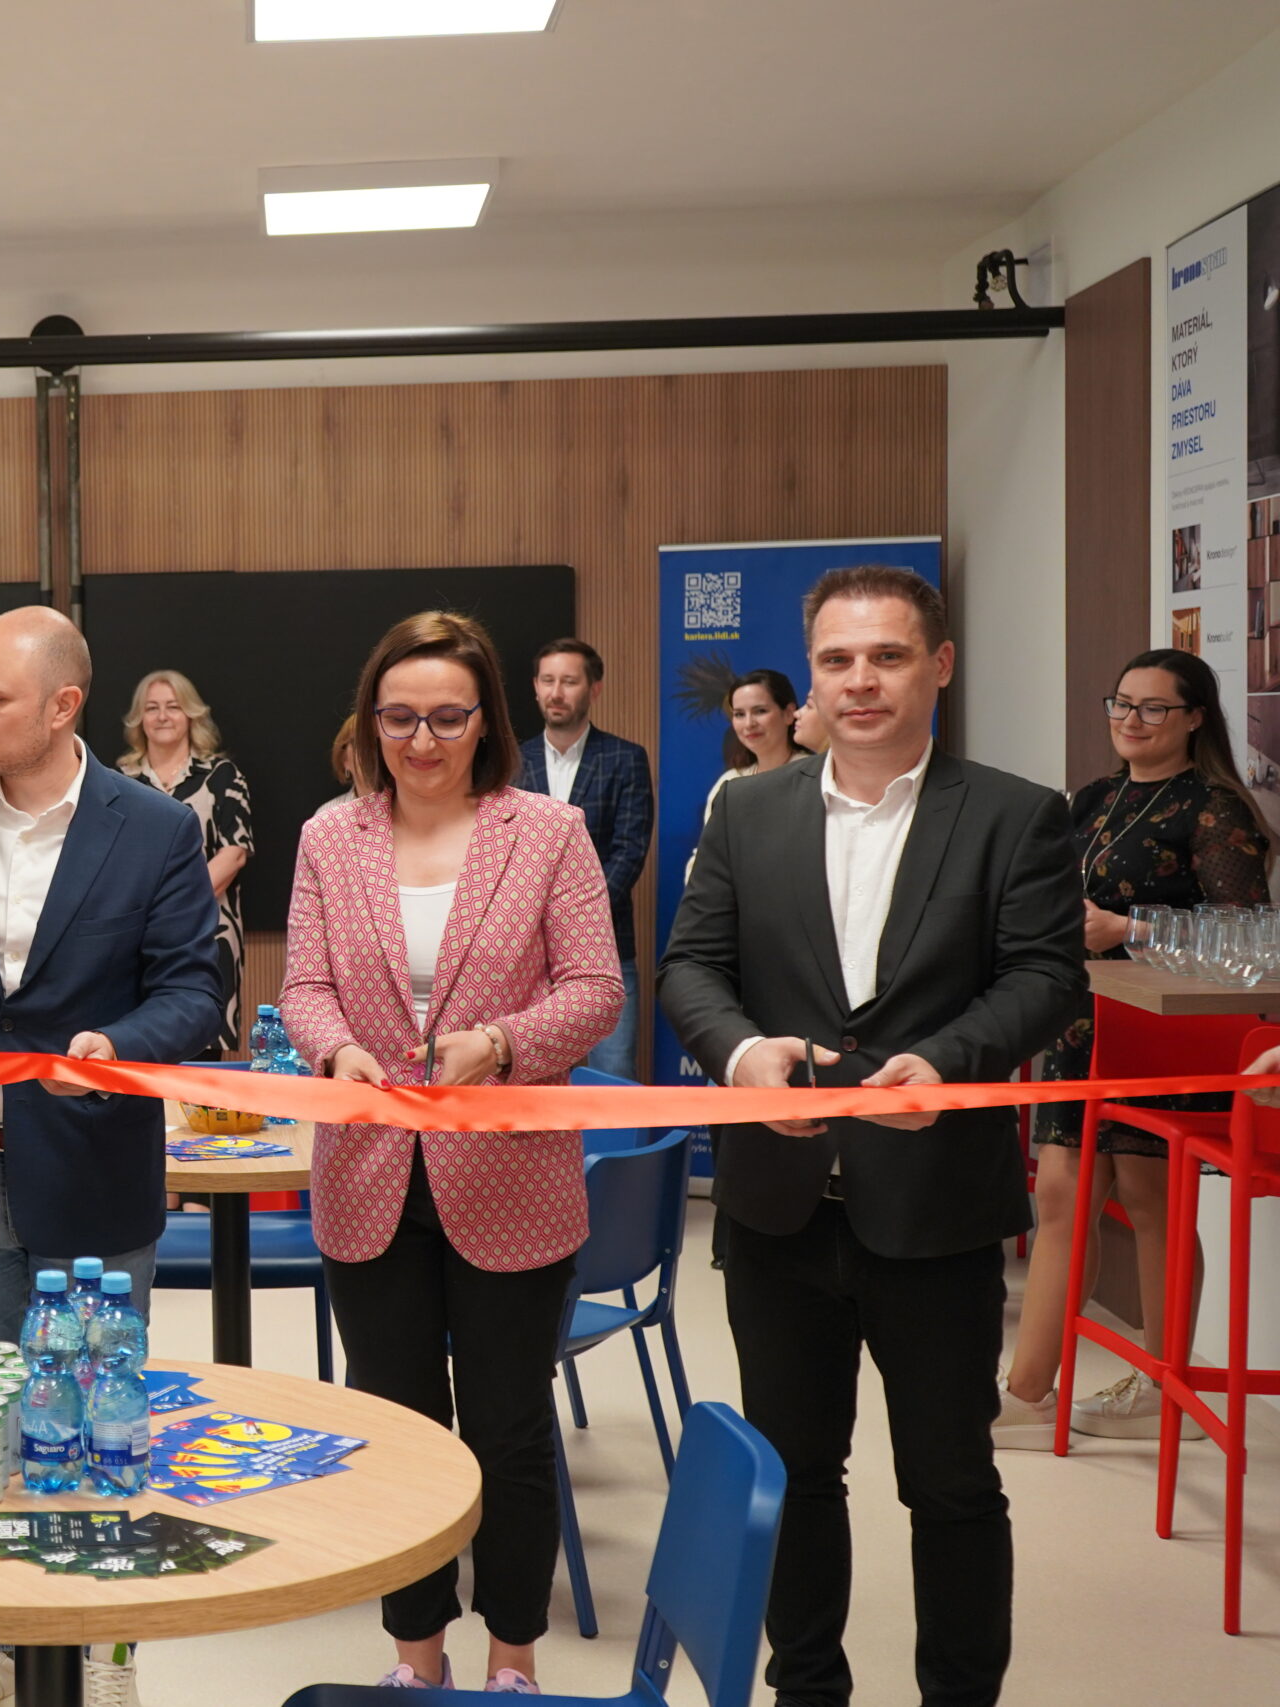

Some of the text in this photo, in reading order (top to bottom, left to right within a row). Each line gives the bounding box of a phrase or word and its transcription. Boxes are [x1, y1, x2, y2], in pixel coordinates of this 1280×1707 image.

[1172, 307, 1213, 342] MATERIÁL,
[1172, 341, 1198, 372] KTORÝ
[1172, 377, 1192, 401] DÁVA
[1172, 400, 1216, 430] PRIESTORU
[1172, 434, 1204, 460] ZMYSEL
[33, 1443, 66, 1455] Saguaro
